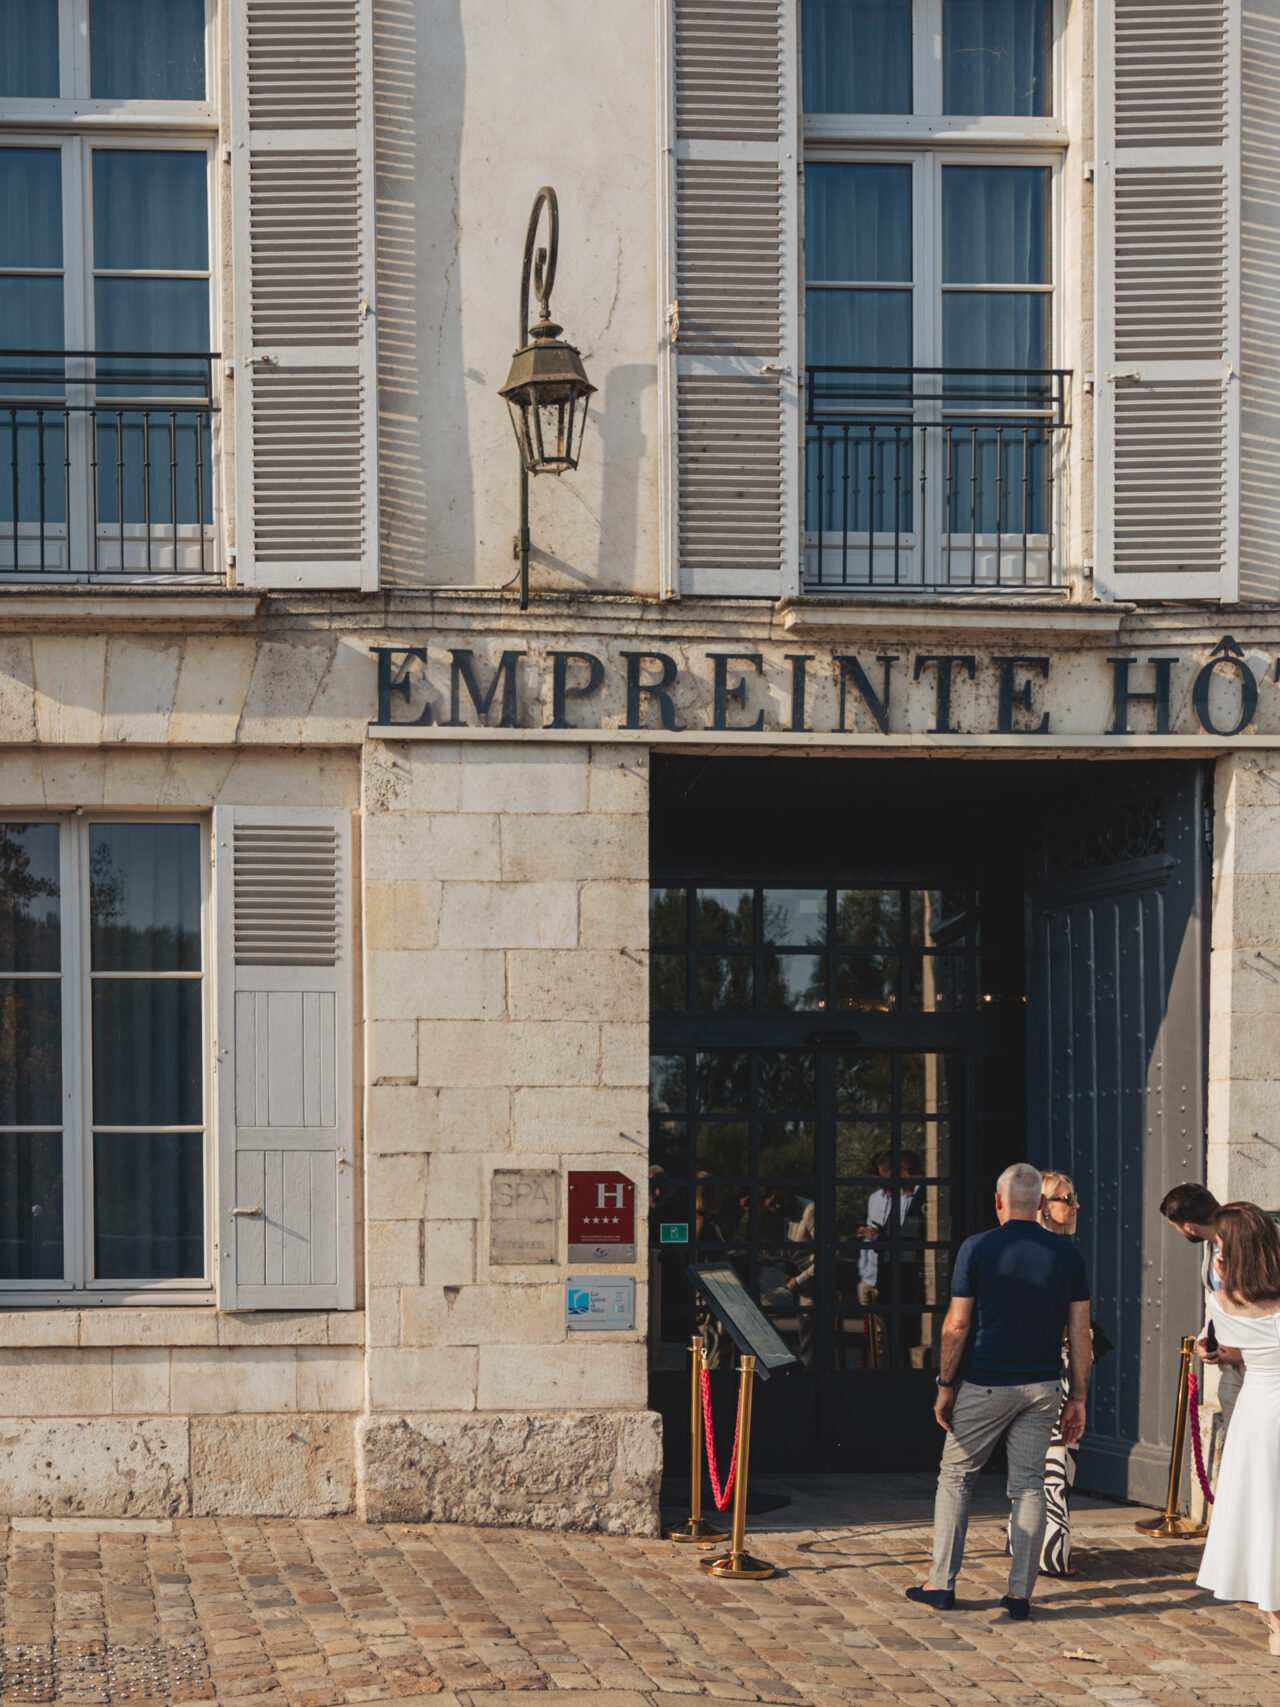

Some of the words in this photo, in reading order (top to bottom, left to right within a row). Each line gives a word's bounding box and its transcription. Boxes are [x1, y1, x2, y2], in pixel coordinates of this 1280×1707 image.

[368, 646, 1051, 735] EMPREINTE
[495, 1182, 550, 1207] SPA
[594, 1183, 627, 1208] H
